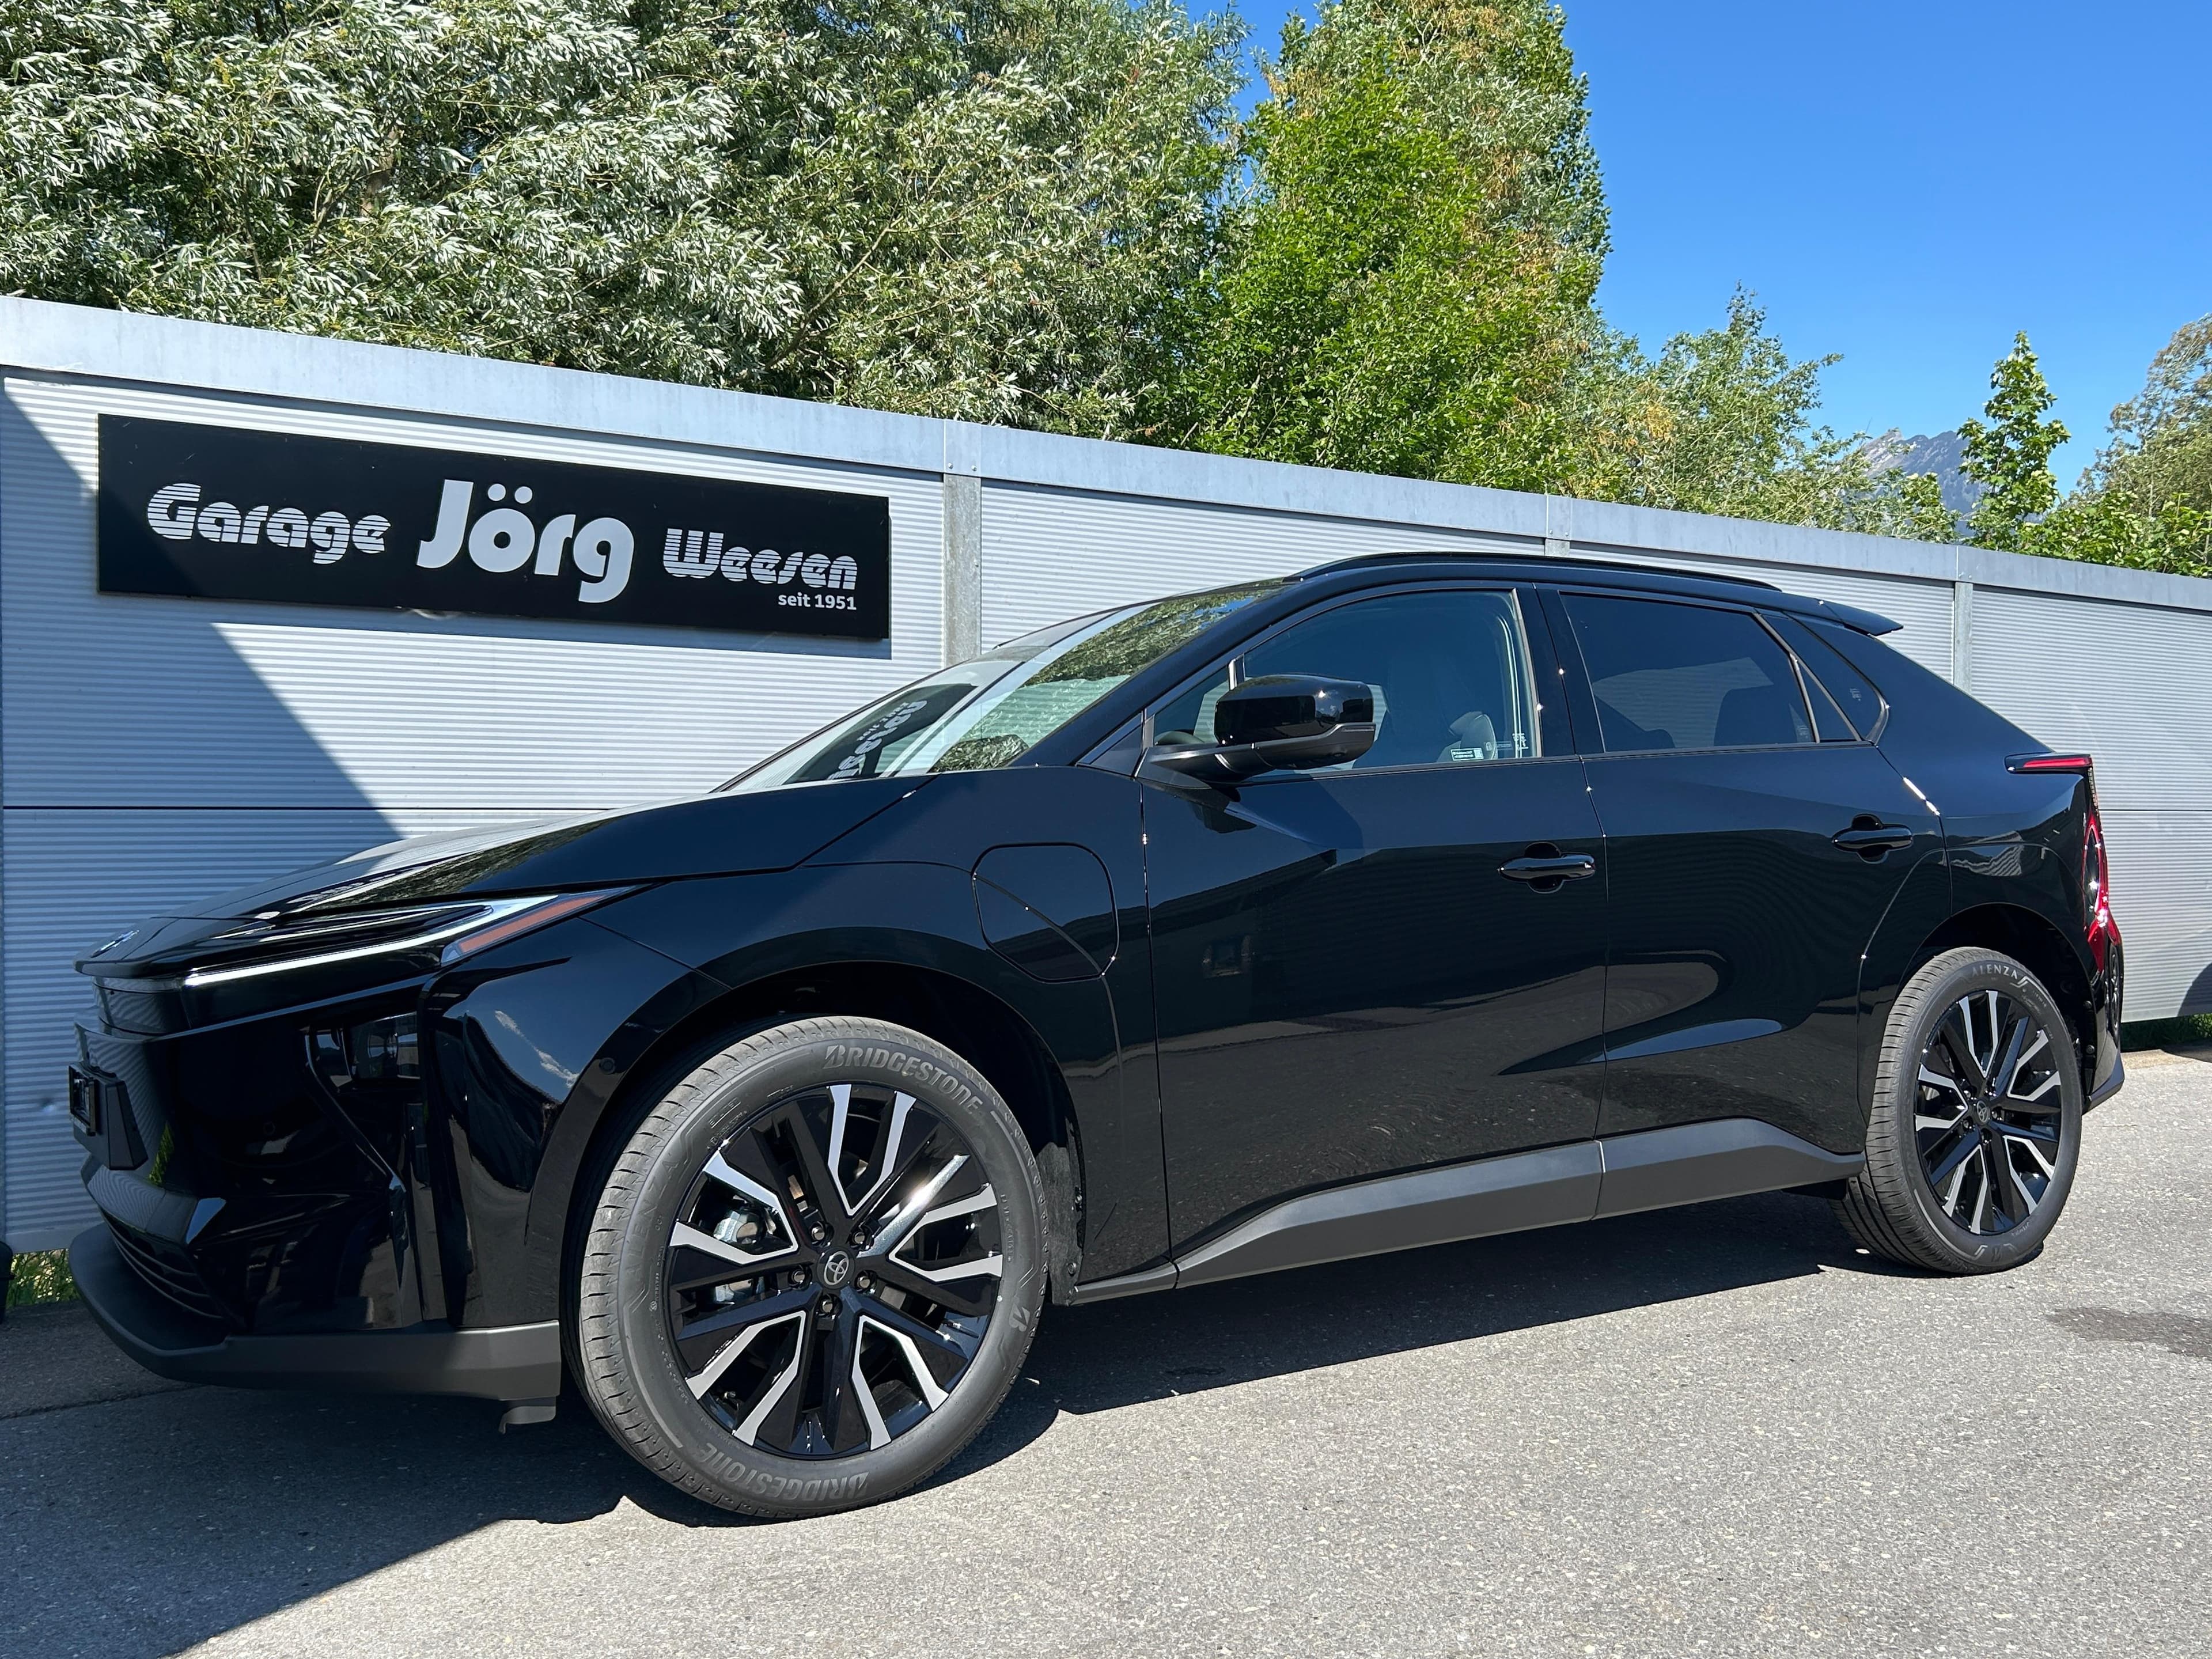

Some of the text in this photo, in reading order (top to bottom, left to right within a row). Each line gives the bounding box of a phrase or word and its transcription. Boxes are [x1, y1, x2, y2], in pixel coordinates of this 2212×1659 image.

[147, 479, 858, 603] Garage Jörg Weesen
[778, 592, 857, 611] seit 1951
[1972, 964, 2018, 979] ALENZA
[823, 1044, 983, 1114] BRIDGESTONE
[693, 1442, 870, 1501] BRIDGESTONE
